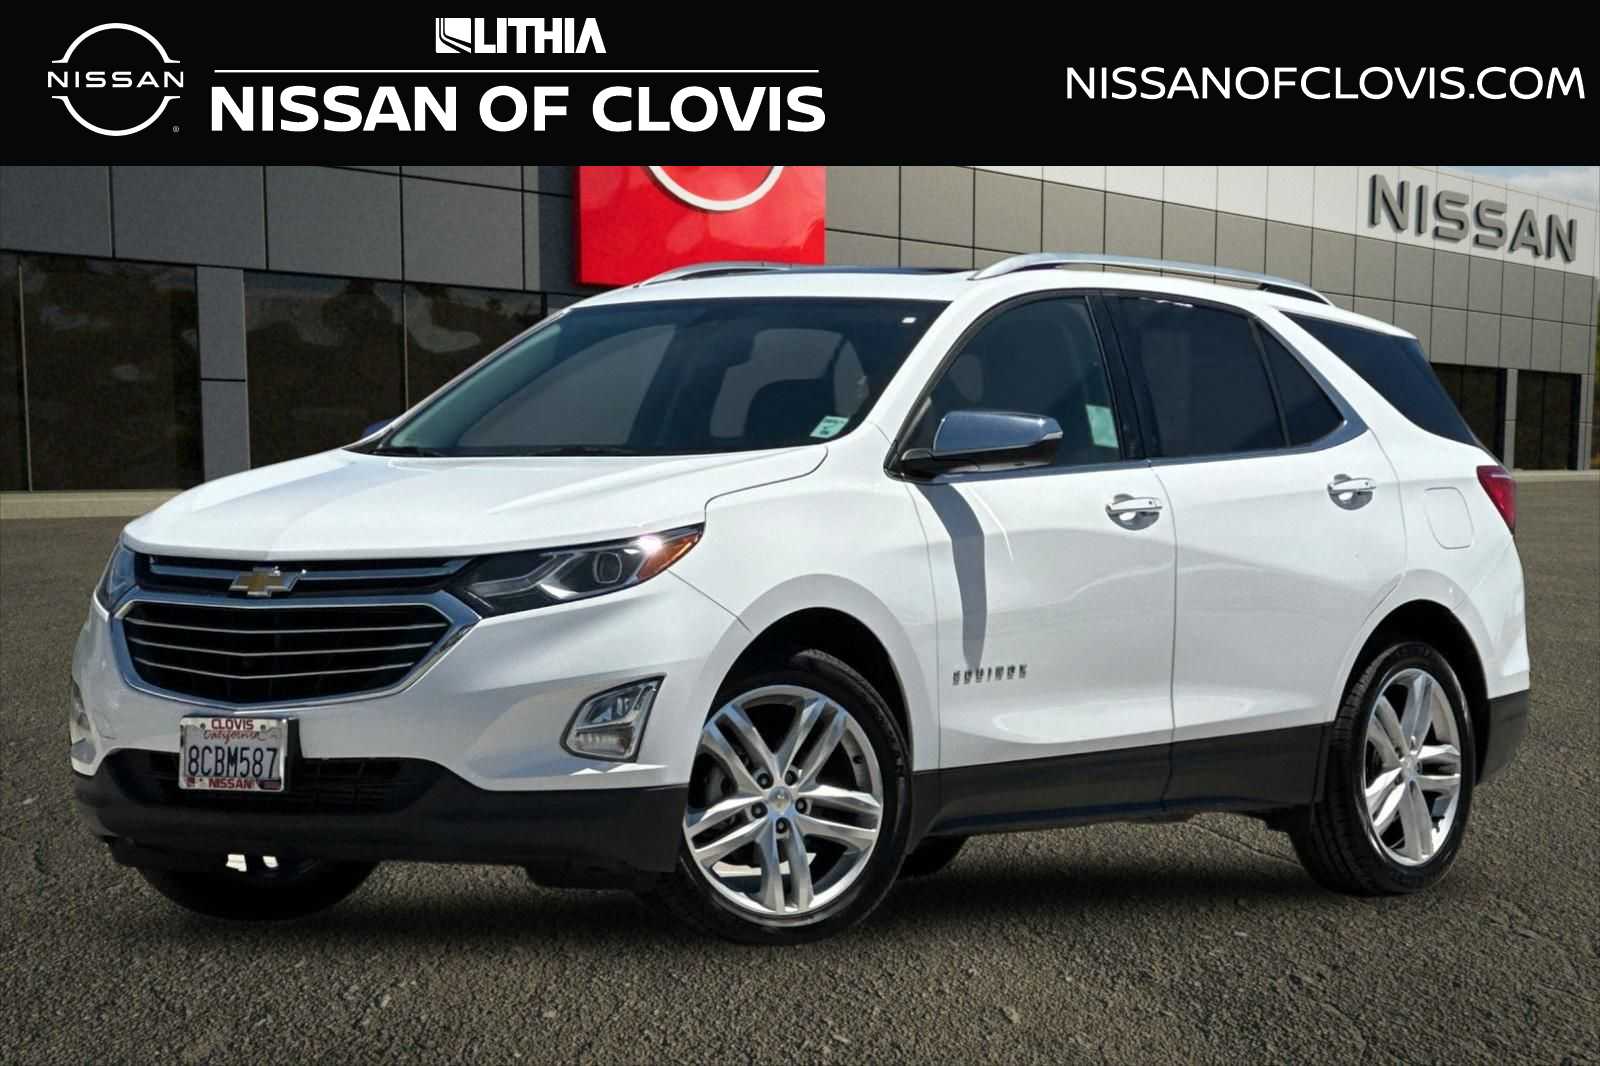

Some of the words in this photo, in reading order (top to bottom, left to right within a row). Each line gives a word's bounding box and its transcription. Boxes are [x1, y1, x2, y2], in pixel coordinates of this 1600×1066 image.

[1368, 174, 1577, 262] NISSAN
[211, 719, 254, 730] CLOVIS
[188, 745, 278, 779] 8CBM587
[208, 778, 252, 789] NISSAN
